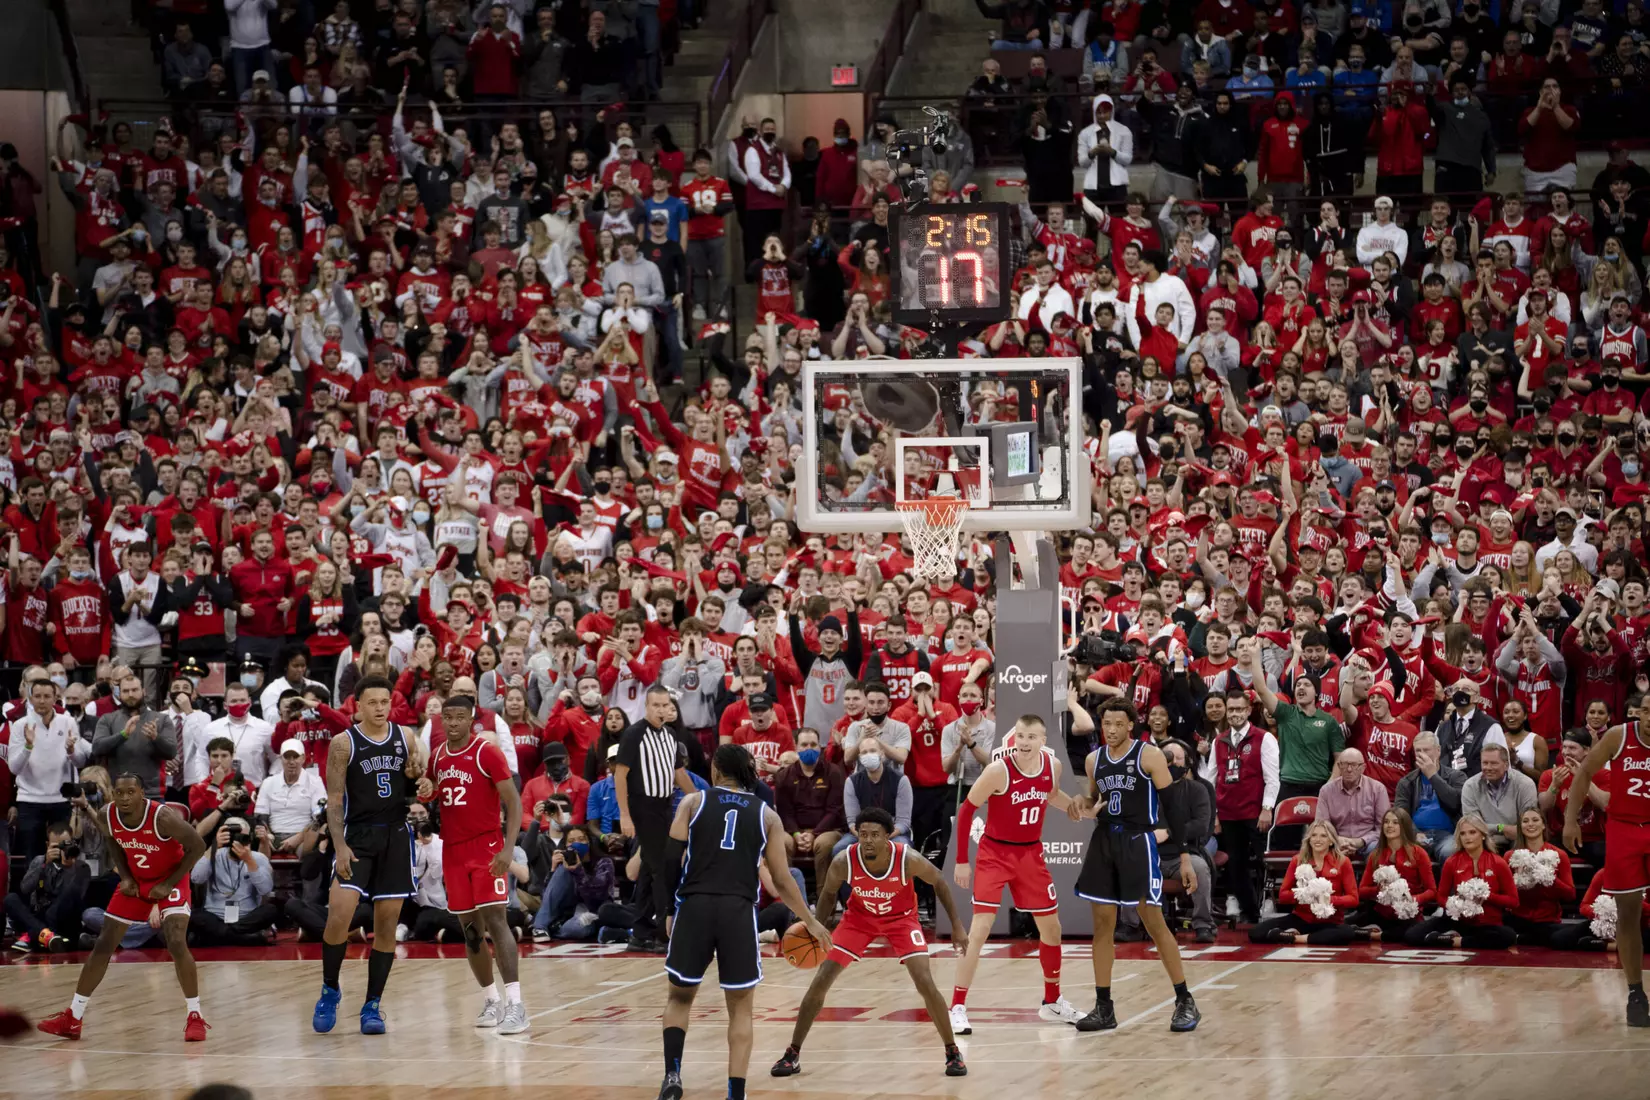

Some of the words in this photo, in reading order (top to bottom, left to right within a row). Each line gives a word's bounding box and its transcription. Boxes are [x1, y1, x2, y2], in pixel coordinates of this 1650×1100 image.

[926, 215, 991, 247] 2:15
[940, 251, 984, 304] 17
[194, 602, 213, 616] 33
[886, 678, 910, 699] 23
[998, 664, 1048, 693] Kroger
[1530, 693, 1537, 713] 1
[360, 755, 403, 775] DUKE
[1623, 756, 1650, 772] Buck
[437, 764, 472, 785] Buckeyes
[1097, 774, 1137, 794] DUKE
[376, 772, 392, 798] 5
[442, 786, 467, 806] 32
[718, 793, 750, 808] KEELS
[1019, 806, 1040, 826] 10
[719, 808, 738, 850] 1
[116, 838, 160, 853] Buckeyes
[1042, 841, 1083, 854] REDIT
[134, 854, 150, 868] 2
[1044, 856, 1082, 865] AMERICA
[863, 900, 893, 915] 55
